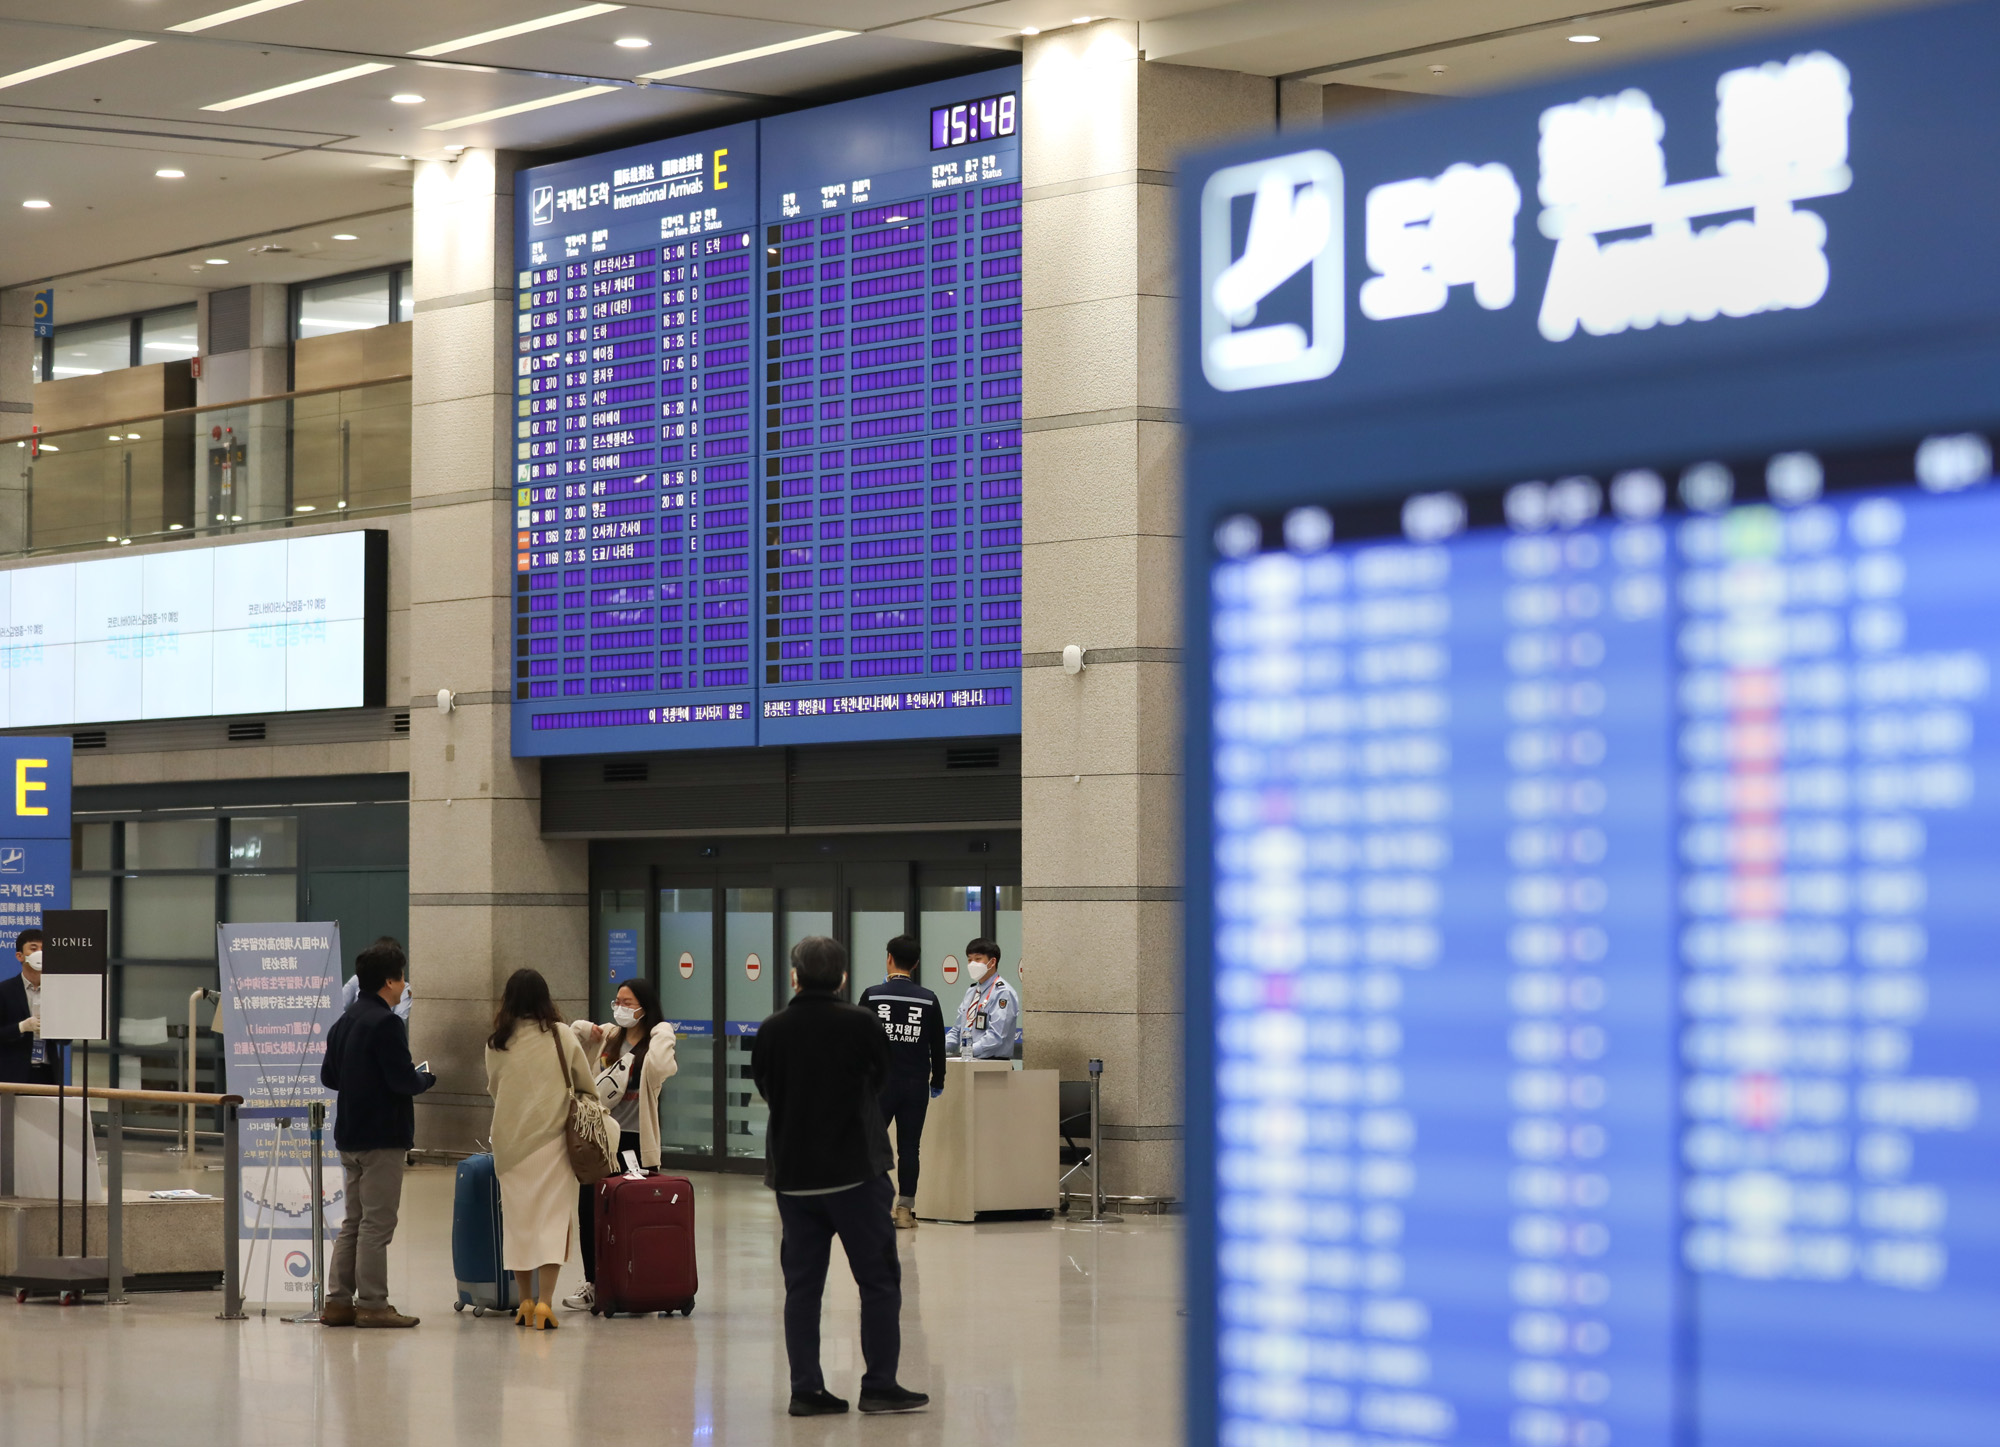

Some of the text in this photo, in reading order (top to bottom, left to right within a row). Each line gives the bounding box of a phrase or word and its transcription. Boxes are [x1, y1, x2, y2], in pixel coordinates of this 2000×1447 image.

[942, 94, 1016, 145] 15:48
[713, 148, 728, 190] E
[557, 182, 610, 213] 국제선 도착
[614, 176, 703, 210] International Arrivals
[783, 168, 1003, 217] Flight Time From New Time Exit Status
[566, 248, 579, 257] Time
[592, 243, 606, 252] From
[661, 230, 674, 239] New
[674, 227, 688, 236] Time
[690, 223, 701, 234] Exit
[704, 220, 723, 231] Status
[533, 273, 541, 284] UA
[692, 243, 698, 255] E
[705, 238, 721, 253] 도착
[614, 276, 635, 292] 케네디
[692, 266, 698, 277] A
[533, 315, 541, 327] CZ
[610, 299, 632, 315] (대련)
[692, 288, 698, 300] B
[532, 337, 541, 348] QR
[593, 325, 608, 339] 도하
[692, 310, 697, 322] E
[532, 358, 541, 370] CA
[592, 346, 614, 361] 베이징
[691, 333, 697, 344] E
[593, 368, 614, 383] 광저우
[691, 355, 698, 367] B
[592, 391, 607, 404] 시안
[691, 378, 698, 389] B
[592, 410, 620, 426] 타이베이
[691, 400, 698, 411] A
[691, 423, 698, 434] B
[532, 466, 540, 477] BR
[592, 454, 620, 470] 타이베이
[691, 445, 697, 457] E
[531, 490, 539, 501] LJ
[592, 482, 607, 495] 세부
[691, 470, 697, 482] B
[592, 503, 607, 517] 양곤
[691, 493, 697, 504] E
[532, 533, 539, 544] 7C
[592, 524, 618, 538] 오사카/
[619, 521, 641, 536] 간사이
[691, 515, 696, 527] E
[531, 554, 539, 565] 7C
[612, 544, 634, 558] 나리타
[691, 538, 697, 549] E
[248, 599, 313, 615] 코로나바이러스감염증-19
[649, 708, 656, 723] 이
[662, 706, 689, 722] 전광판에
[695, 705, 723, 720] 표시되지
[728, 703, 743, 719] 않은
[764, 701, 791, 717] 항공편은
[833, 694, 899, 712] 도착안내모니터에서
[951, 689, 986, 707] 바랍니다.
[16, 759, 48, 815] E
[0, 884, 55, 897] 국제선도착
[52, 937, 93, 947] SIGNIEL
[882, 1022, 921, 1036] 장지원팀
[900, 1035, 919, 1043] ARMY
